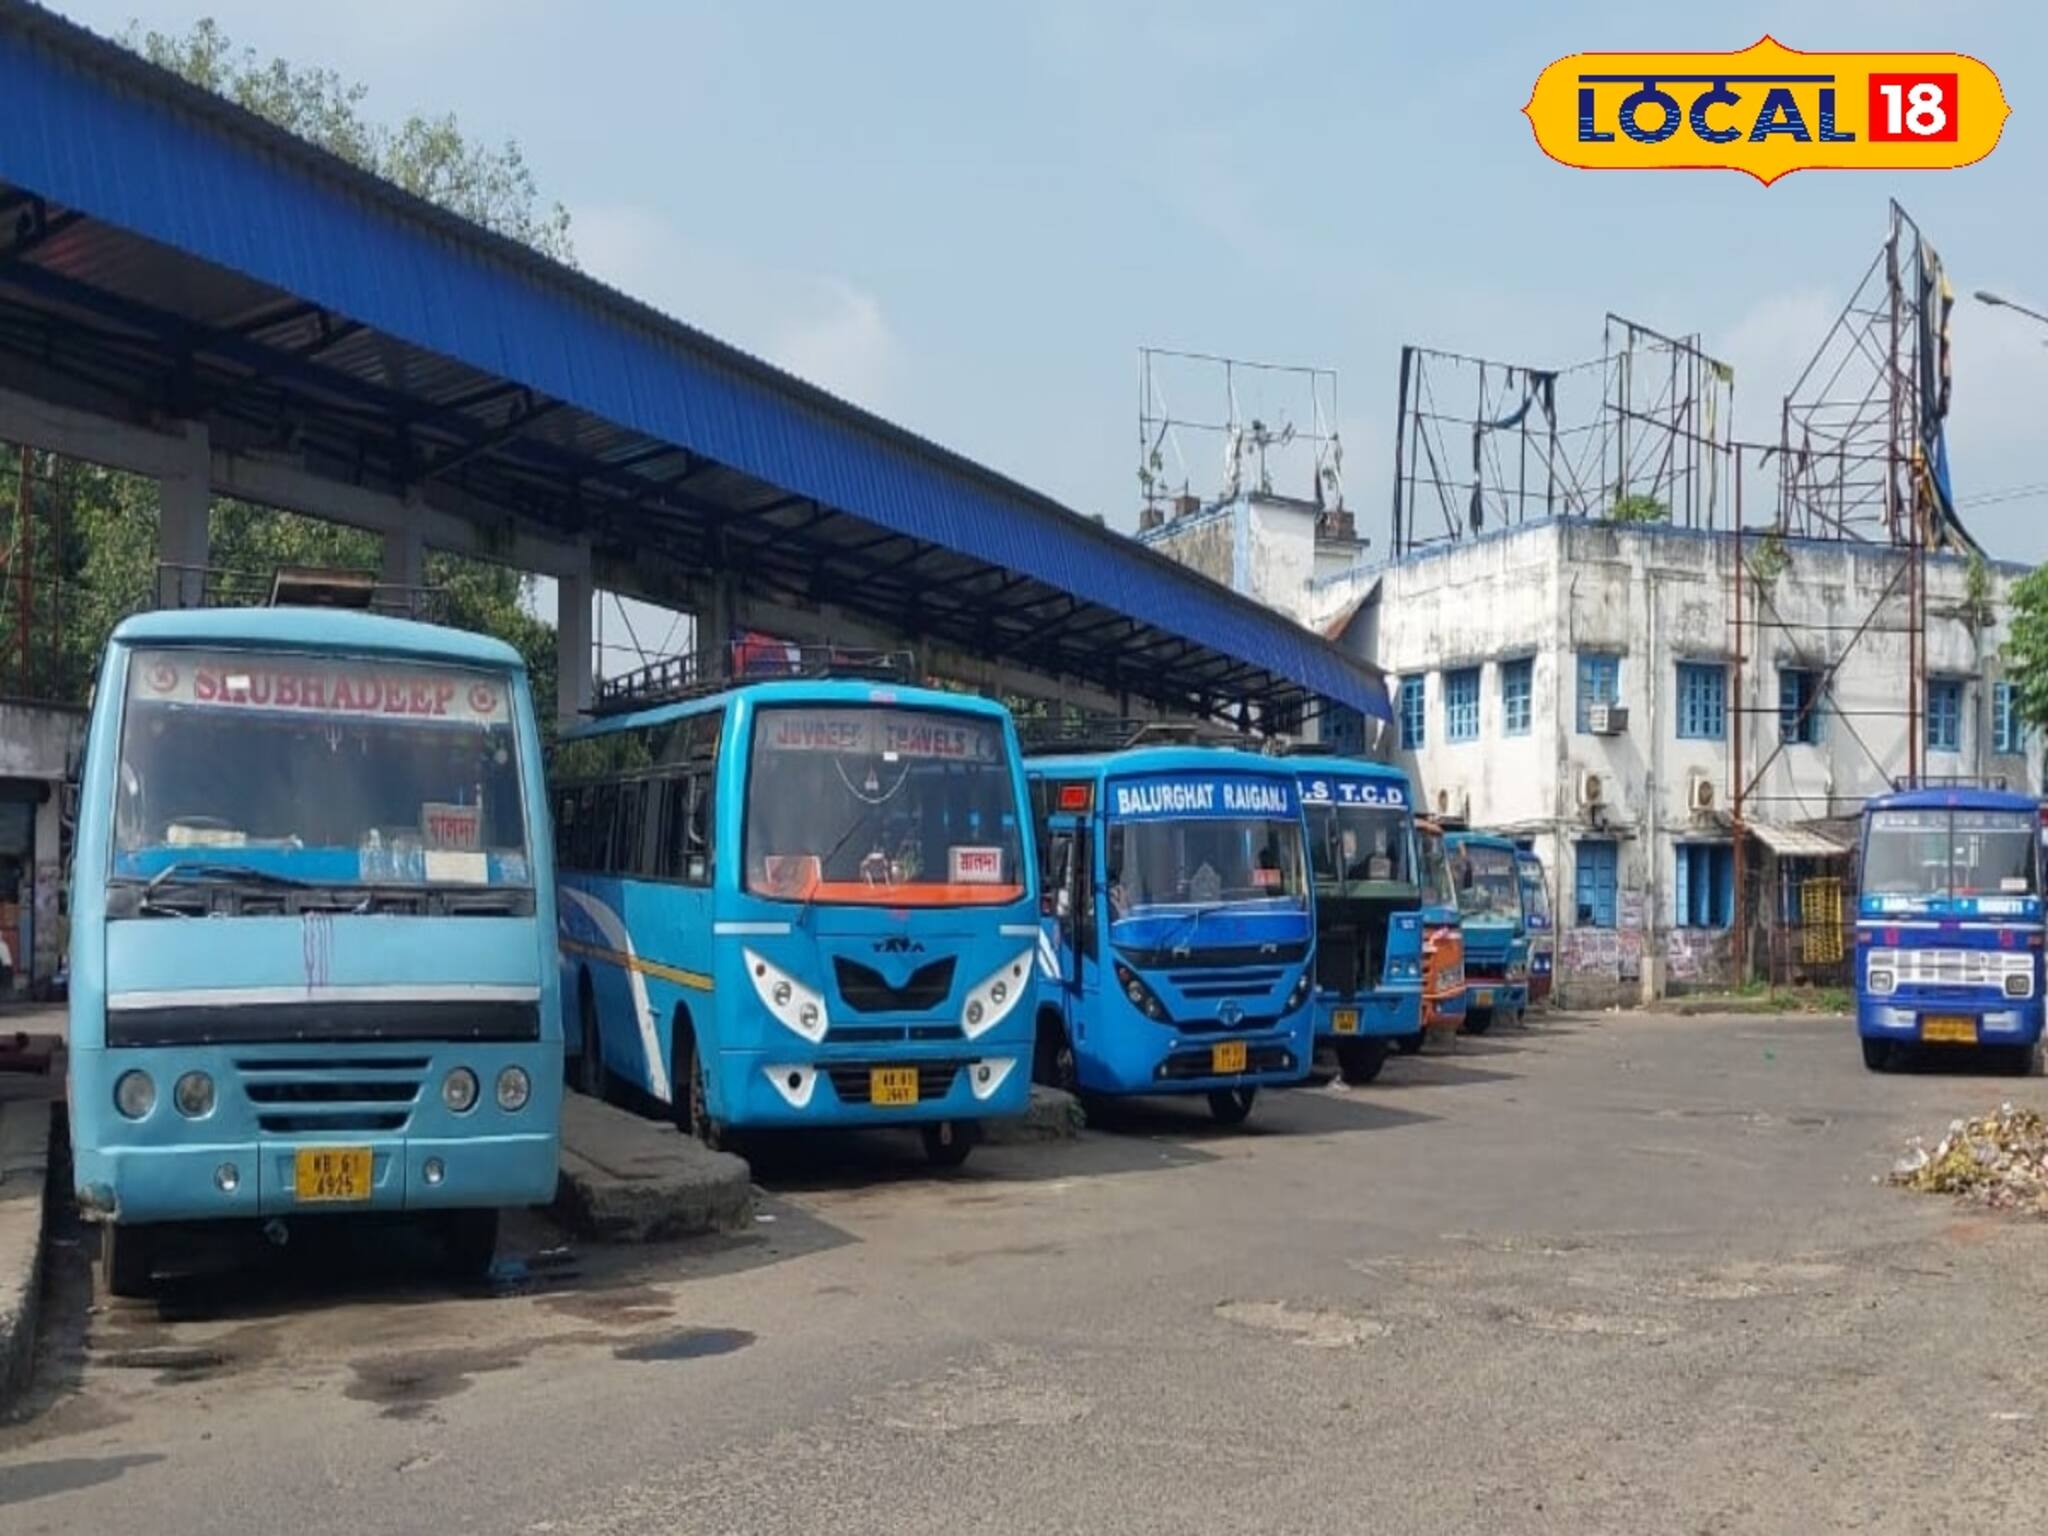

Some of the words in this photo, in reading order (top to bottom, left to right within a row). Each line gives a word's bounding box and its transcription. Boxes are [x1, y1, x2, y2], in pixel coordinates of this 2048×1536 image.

[194, 668, 456, 716] SHUBHADEEP
[887, 725, 966, 755] TRAVELS
[1117, 783, 1214, 814] BALURGHAT
[1222, 783, 1288, 812] RAIGANJ
[873, 937, 926, 953] TATA
[313, 1153, 332, 1174] WB
